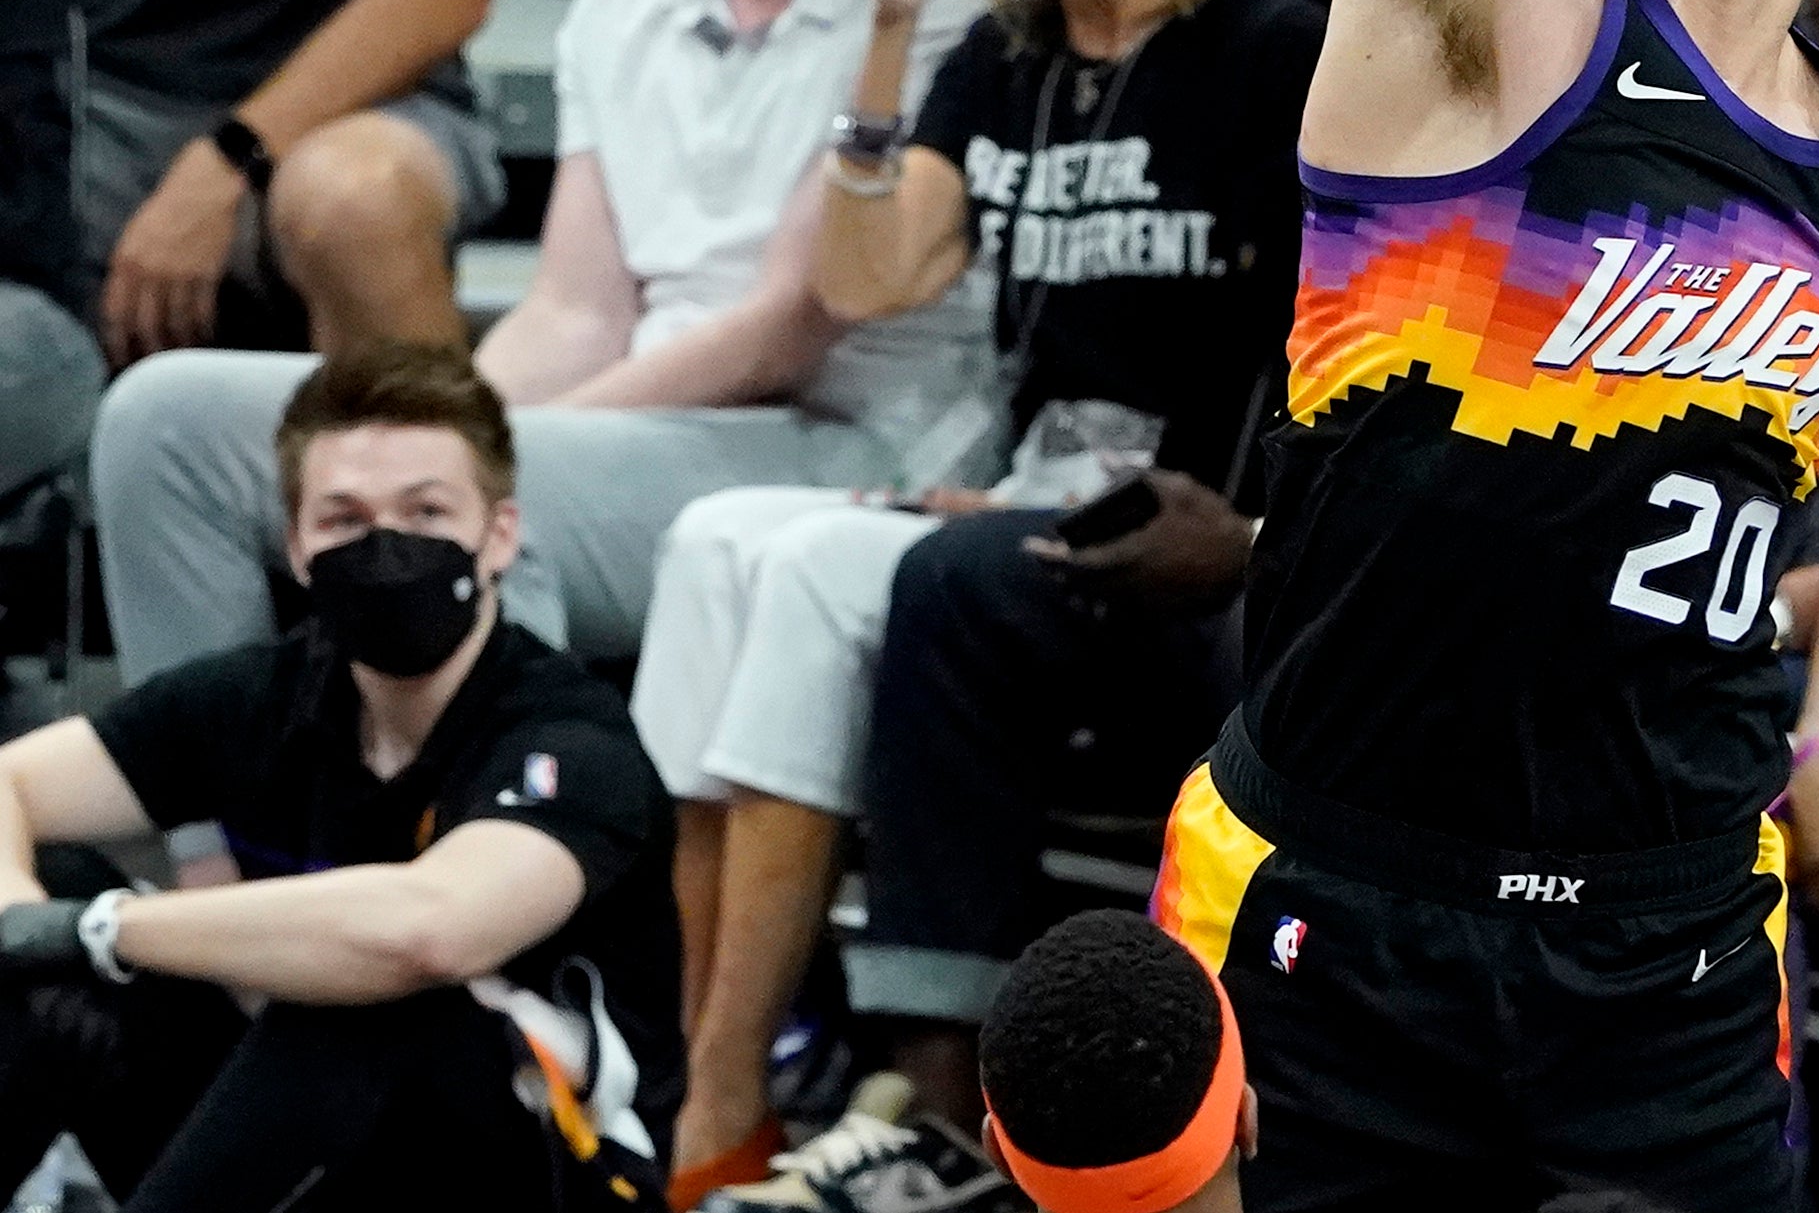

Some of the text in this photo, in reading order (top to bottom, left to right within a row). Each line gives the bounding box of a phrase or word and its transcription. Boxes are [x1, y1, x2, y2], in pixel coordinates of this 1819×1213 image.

[1664, 262, 1732, 292] THE
[1609, 469, 1782, 643] 20
[1497, 874, 1586, 904] PHX
